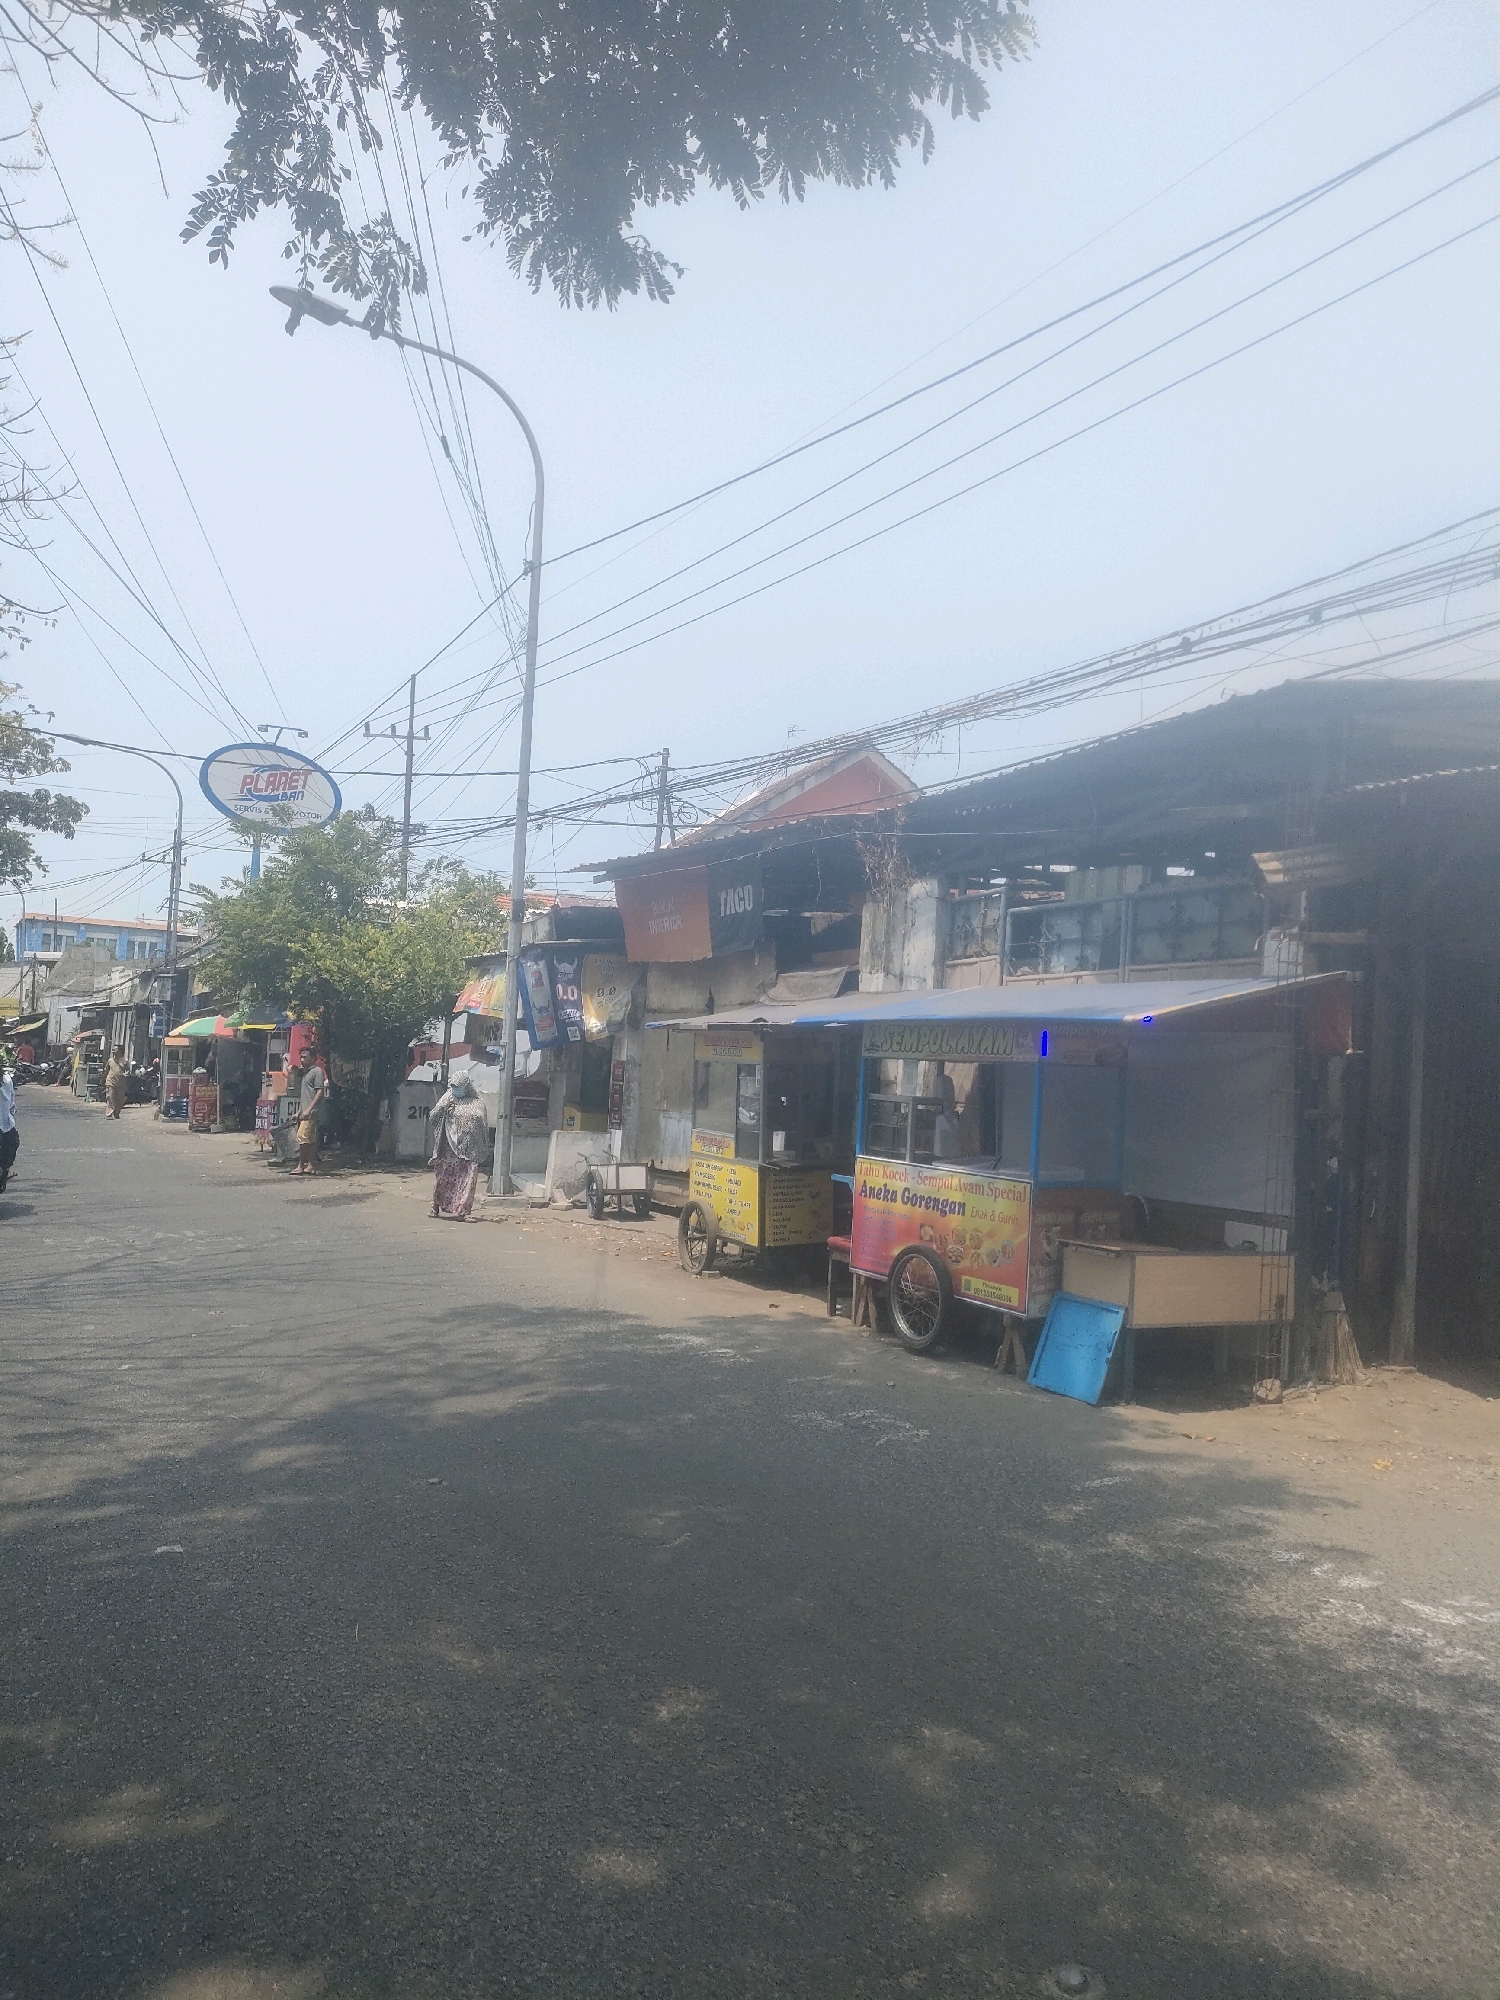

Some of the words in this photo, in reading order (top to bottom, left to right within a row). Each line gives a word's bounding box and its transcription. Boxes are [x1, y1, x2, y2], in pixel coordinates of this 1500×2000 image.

[239, 770, 313, 795] PLANET
[280, 790, 305, 802] BAN
[233, 804, 263, 815] SERVIS
[291, 810, 323, 820] MOTOR
[720, 884, 754, 917] TACO
[648, 914, 683, 935] INTERIOR
[880, 1023, 953, 1055] SEMPOL
[955, 1024, 1015, 1056] AYAM
[858, 1161, 880, 1178] Tahu
[882, 1165, 910, 1183] Kocek
[916, 1170, 954, 1192] Sempol
[955, 1176, 985, 1197] Ayam
[986, 1181, 1028, 1203] Special
[858, 1179, 898, 1204] Aneka
[900, 1186, 967, 1218] Gorengan
[970, 1206, 988, 1220] Enak
[989, 1209, 997, 1222] &
[998, 1211, 1019, 1226] Gurih
